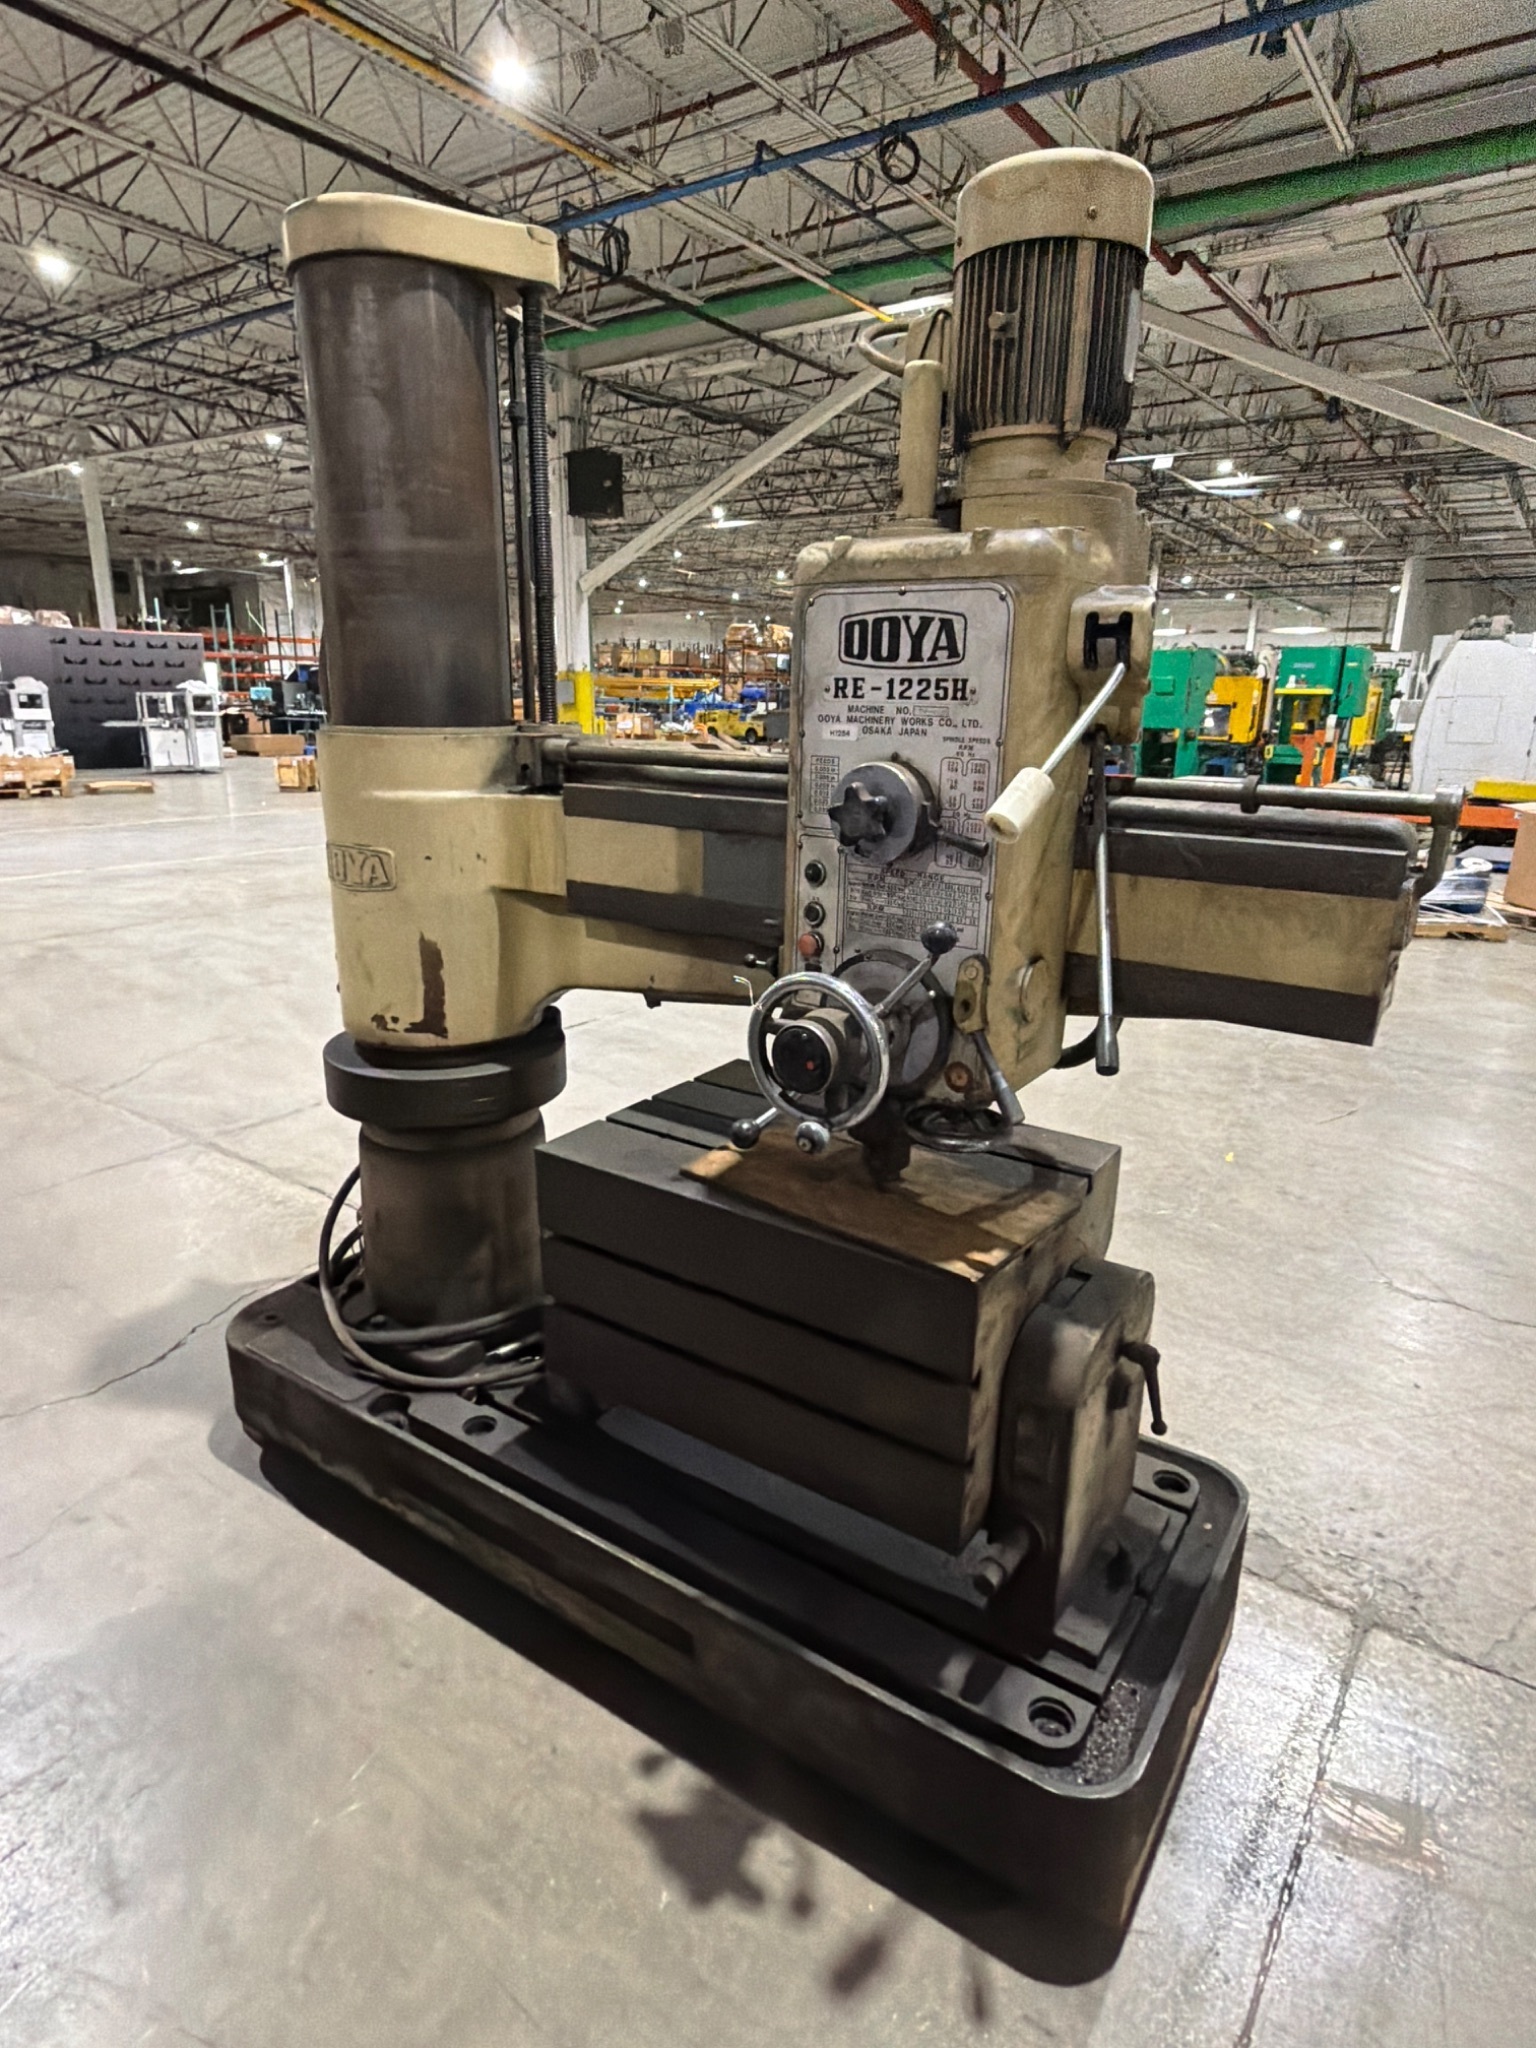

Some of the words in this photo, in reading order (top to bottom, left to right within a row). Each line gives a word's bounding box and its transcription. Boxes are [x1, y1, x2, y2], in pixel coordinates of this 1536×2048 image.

[844, 615, 961, 662] OOYA
[833, 677, 969, 701] RE-1225H
[847, 705, 885, 715] MACHINE
[896, 706, 912, 716] NO.
[817, 714, 841, 723] OOYA
[846, 715, 895, 726] MACHINERY
[901, 718, 934, 727] WORKS
[962, 719, 983, 729] LTD.
[862, 726, 892, 735] OSAKA
[898, 727, 928, 737] JAPAN
